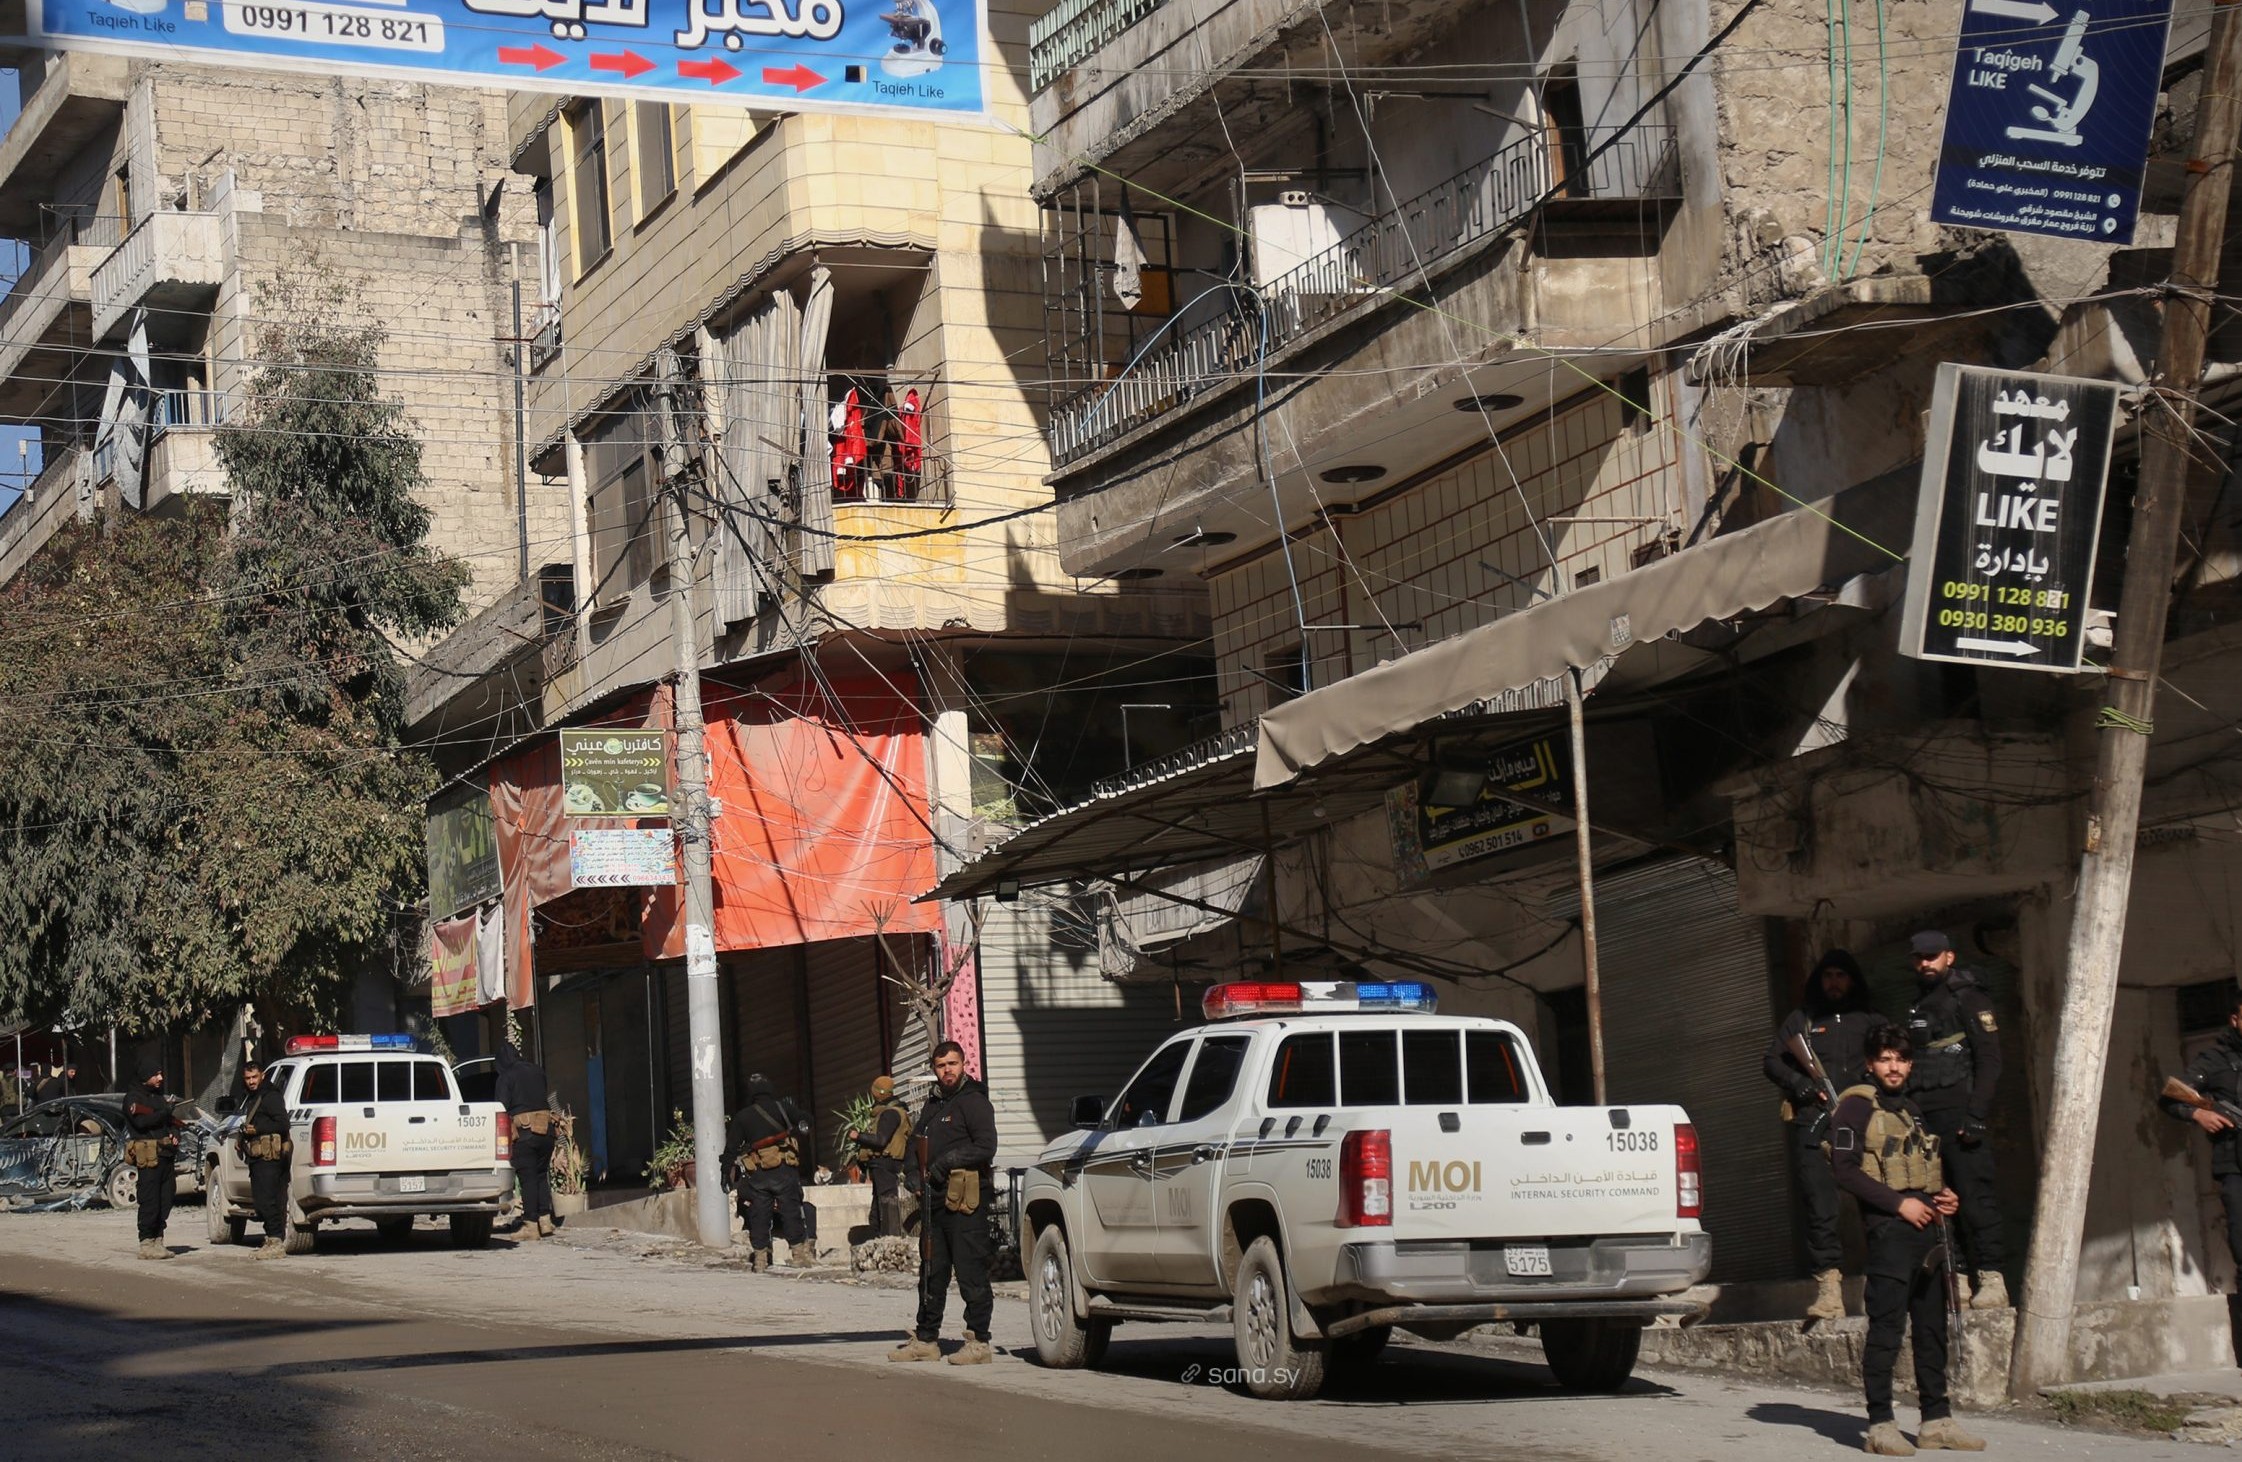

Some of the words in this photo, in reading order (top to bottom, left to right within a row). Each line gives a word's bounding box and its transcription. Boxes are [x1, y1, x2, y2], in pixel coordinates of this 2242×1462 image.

[144, 16, 176, 33] Like
[242, 5, 307, 33] 0991
[322, 11, 371, 38] 128
[382, 18, 427, 43] 821
[1969, 69, 2008, 89] LIKE
[919, 84, 944, 99] Like
[1979, 154, 2015, 168] المنزلي
[2016, 159, 2050, 171] السحب
[2051, 161, 2077, 174] خدمة
[2077, 165, 2107, 179] تتوفر
[2053, 189, 2073, 200] 0991
[2073, 191, 2087, 201] 128
[2044, 207, 2074, 218] مقصود
[1993, 389, 2070, 422] معهد
[1976, 492, 2060, 533] LIKE
[1975, 542, 2049, 583] بإدارة
[1943, 581, 1990, 602] 0991
[1998, 586, 2032, 606] 128
[2035, 590, 2069, 609] 821
[1940, 609, 1988, 629] 0930
[1991, 614, 2028, 633] 380
[2032, 618, 2068, 637] 936
[566, 738, 603, 756] عيني
[623, 737, 662, 754] كافتريا
[457, 1116, 487, 1128] 15037
[345, 1132, 387, 1149] MOI
[1606, 1131, 1658, 1152] 15038
[1305, 1158, 1332, 1180] 15038
[1408, 1160, 1482, 1192] MOI
[1616, 1169, 1658, 1182] قيادة
[1510, 1173, 1571, 1189] الداخلي
[1573, 1171, 1614, 1185] الأمن
[1168, 1187, 1192, 1217] MOI
[1511, 1190, 1558, 1200] INTERNAL
[1561, 1189, 1606, 1199] SECURITY
[1609, 1187, 1660, 1198] COMMAND
[1508, 1256, 1548, 1273] 5175
